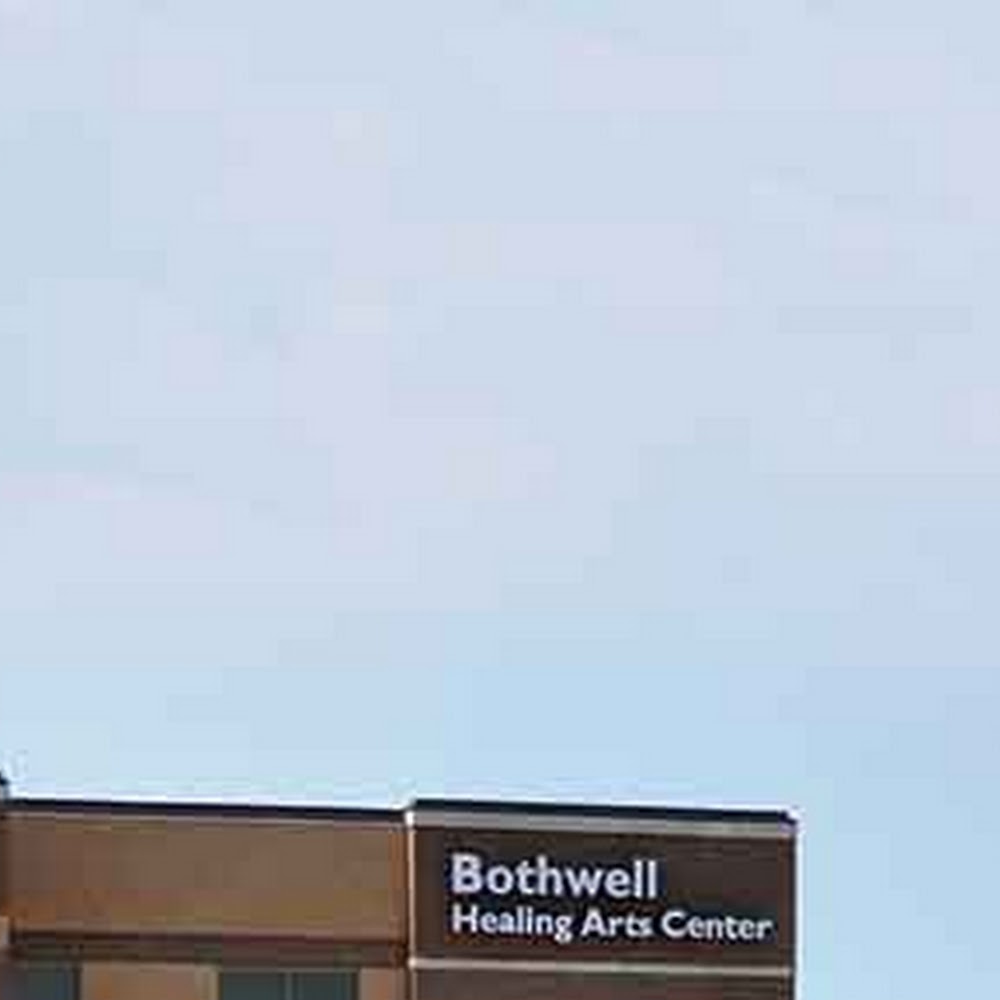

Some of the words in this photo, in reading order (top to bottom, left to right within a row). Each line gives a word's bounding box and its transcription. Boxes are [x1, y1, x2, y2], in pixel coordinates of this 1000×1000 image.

[450, 853, 658, 898] Bothwell
[452, 905, 573, 943] Healing
[580, 907, 653, 937] Arts
[661, 910, 774, 942] Center
